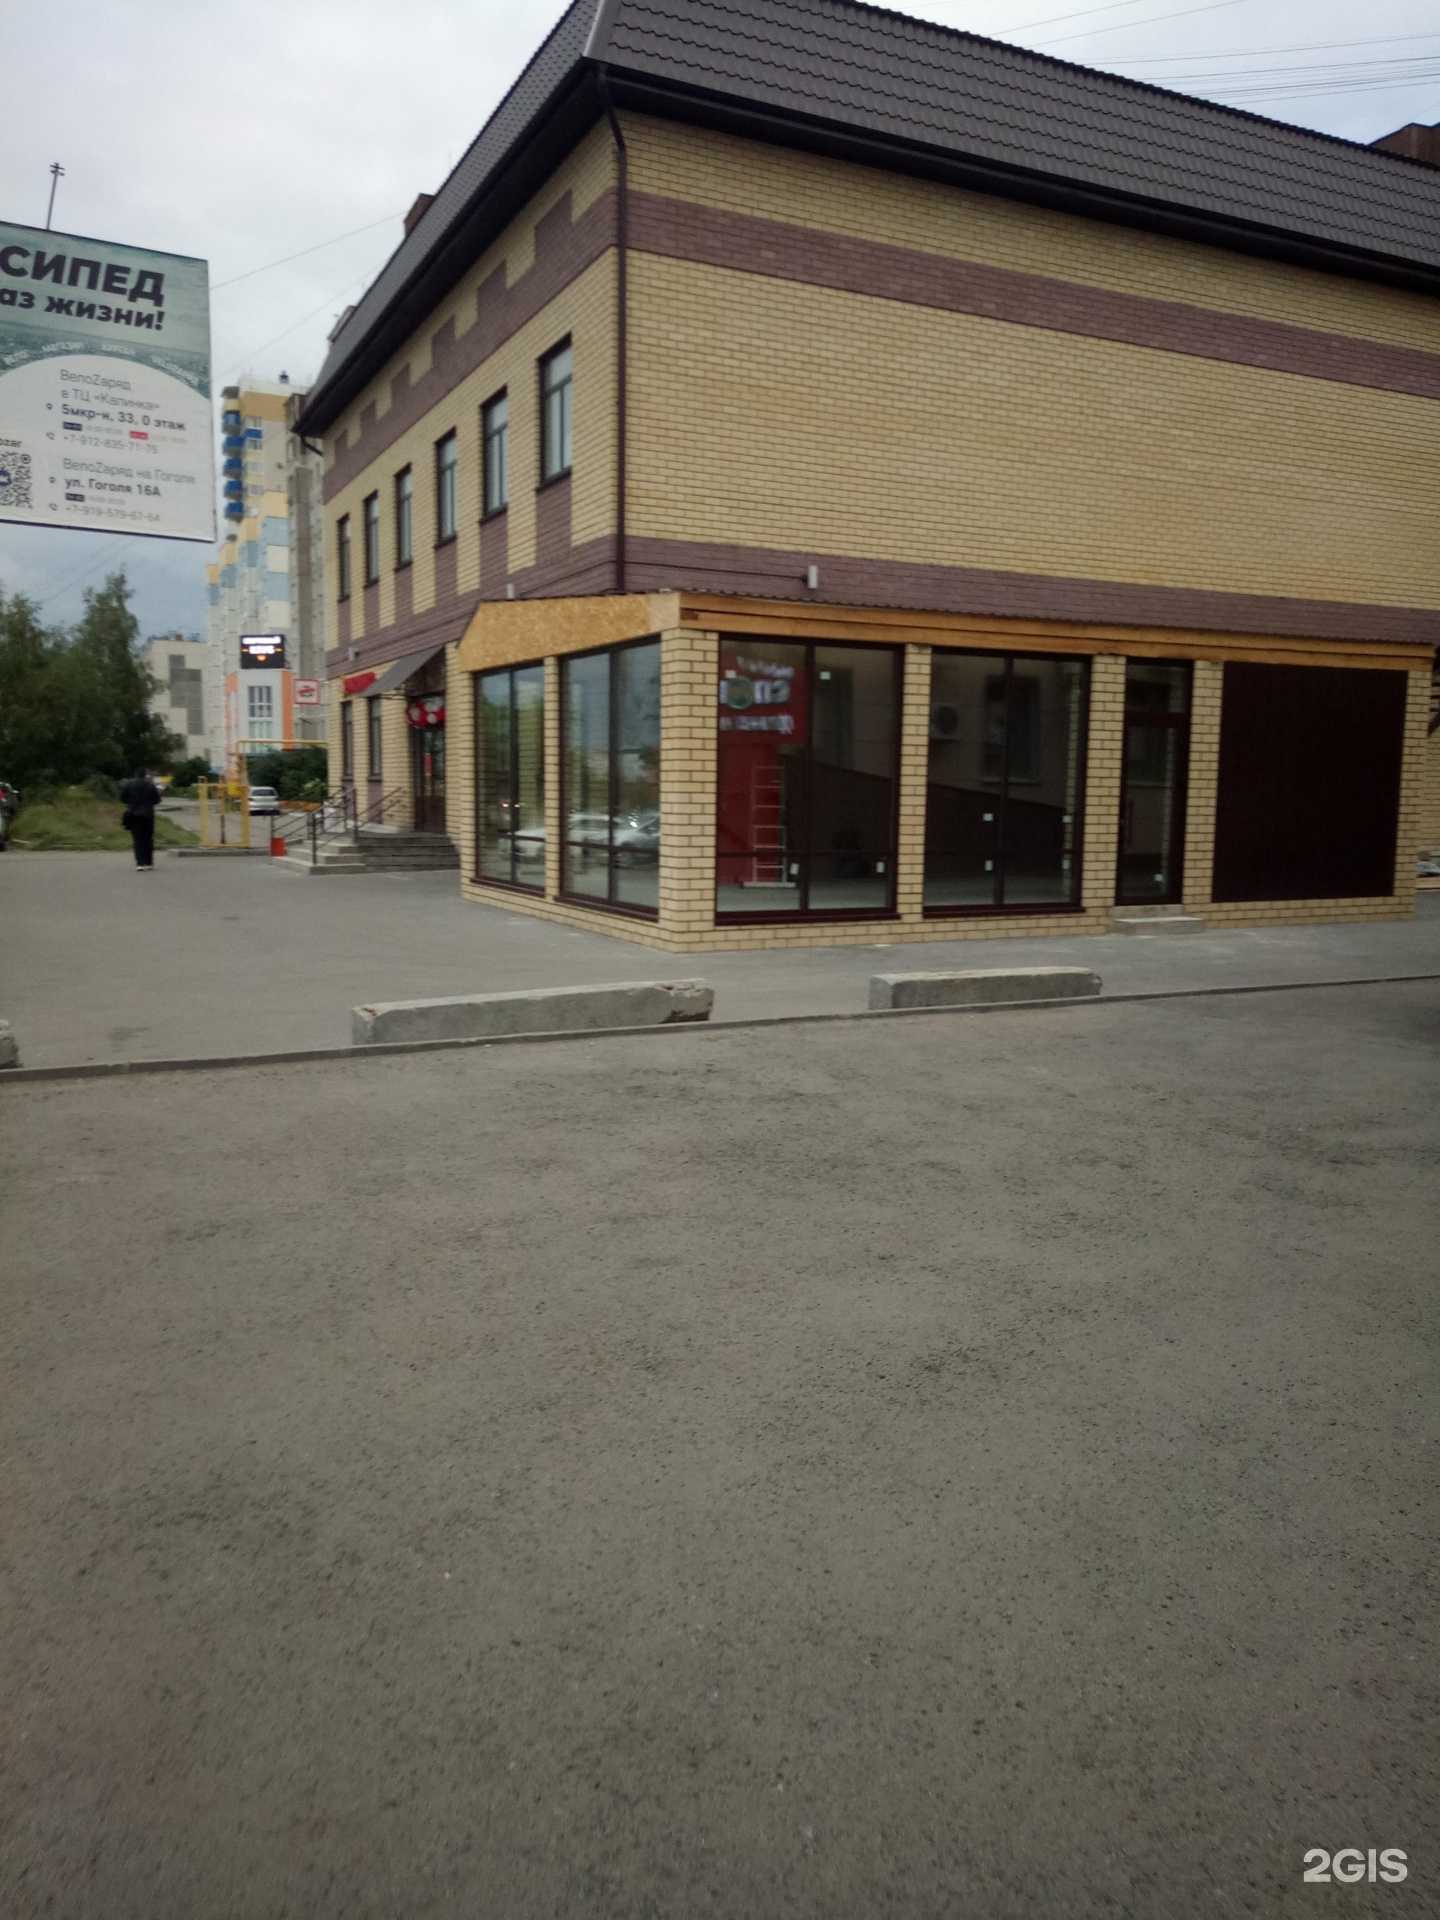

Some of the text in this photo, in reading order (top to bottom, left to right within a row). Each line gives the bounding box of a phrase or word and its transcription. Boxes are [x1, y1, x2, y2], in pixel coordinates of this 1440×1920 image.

[0, 245, 165, 307] СИПЕД
[0, 288, 165, 330] аз жизни!
[72, 388, 90, 402] ТЦ
[155, 419, 187, 431] этаж
[154, 469, 196, 484] Гоголя
[65, 478, 161, 497] ул. Гоголя 16А
